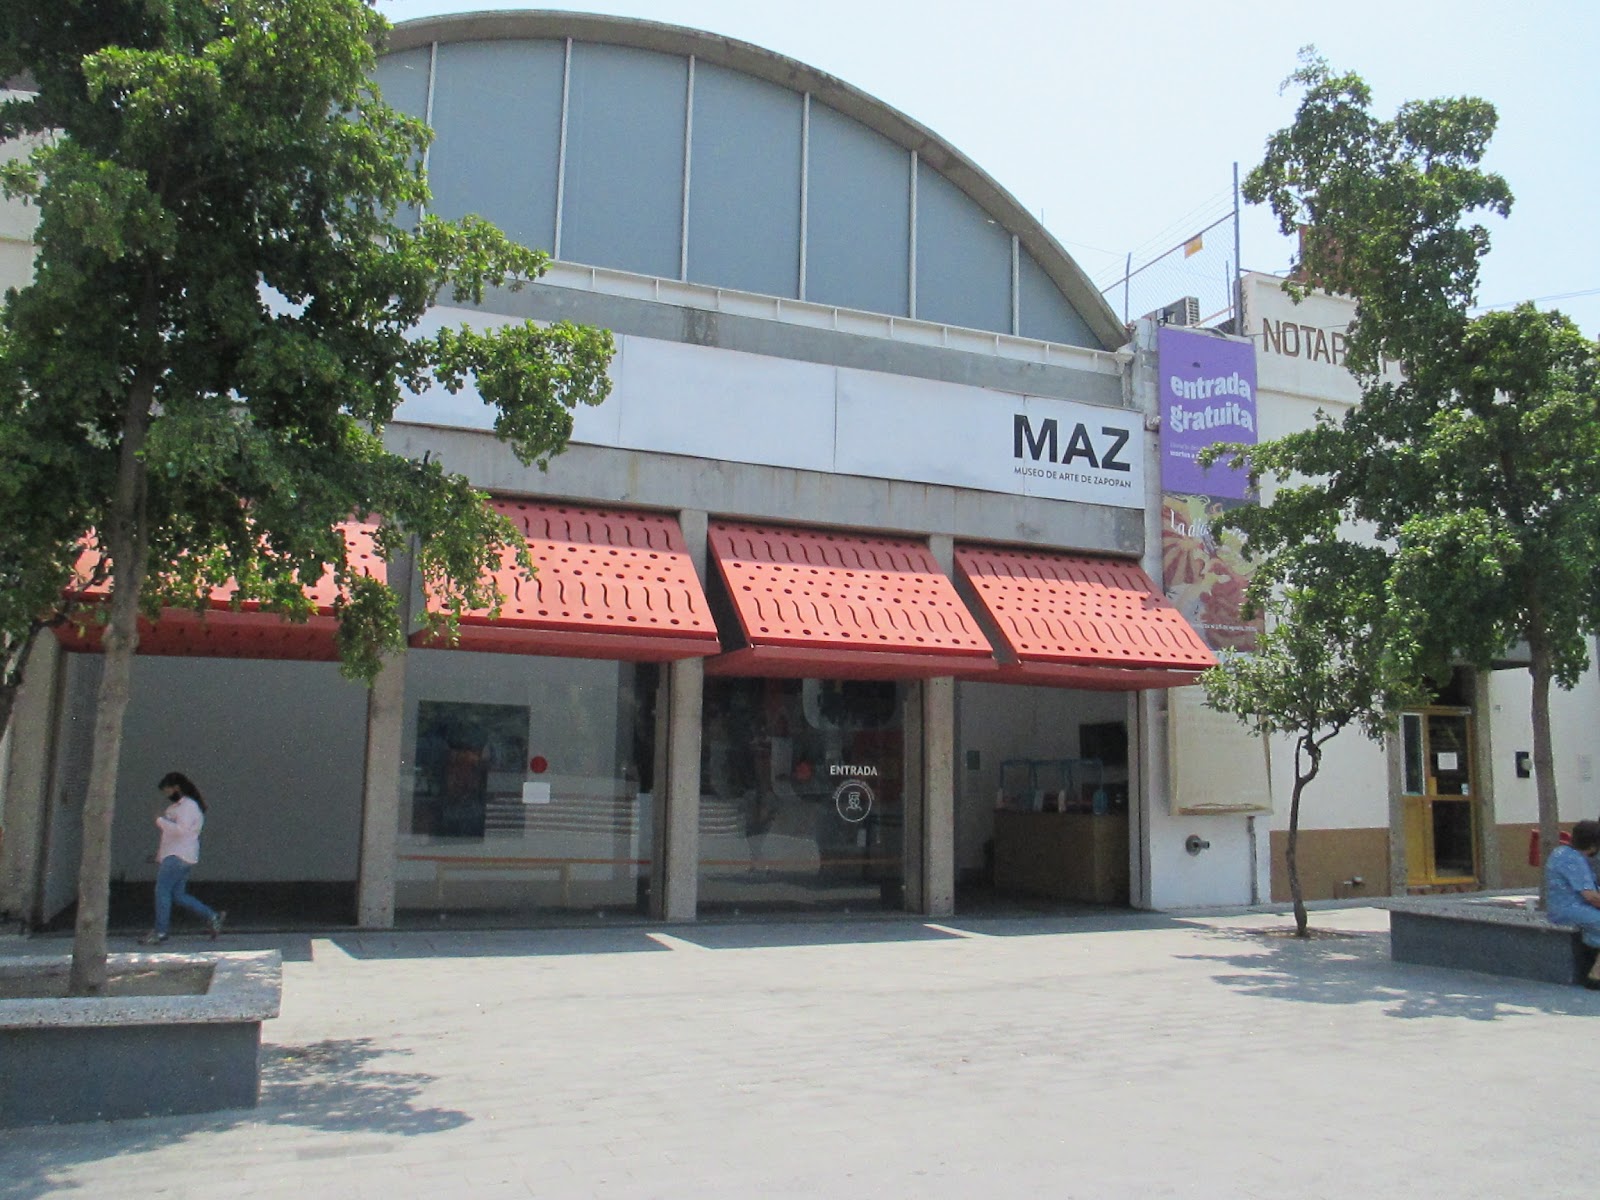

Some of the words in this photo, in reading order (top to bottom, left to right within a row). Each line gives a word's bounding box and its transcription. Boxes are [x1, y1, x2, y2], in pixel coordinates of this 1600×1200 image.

[1263, 318, 1350, 365] NOTAR
[1170, 371, 1252, 402] entrada
[1170, 401, 1254, 433] gratuita
[1013, 413, 1131, 472] MAZ
[1014, 466, 1045, 478] MUSEO
[1046, 470, 1057, 480] DE
[1059, 472, 1079, 483] ARTE
[1081, 475, 1092, 484] DE
[1094, 476, 1132, 489] ZAPOPAN
[829, 765, 878, 776] ENTRADA
